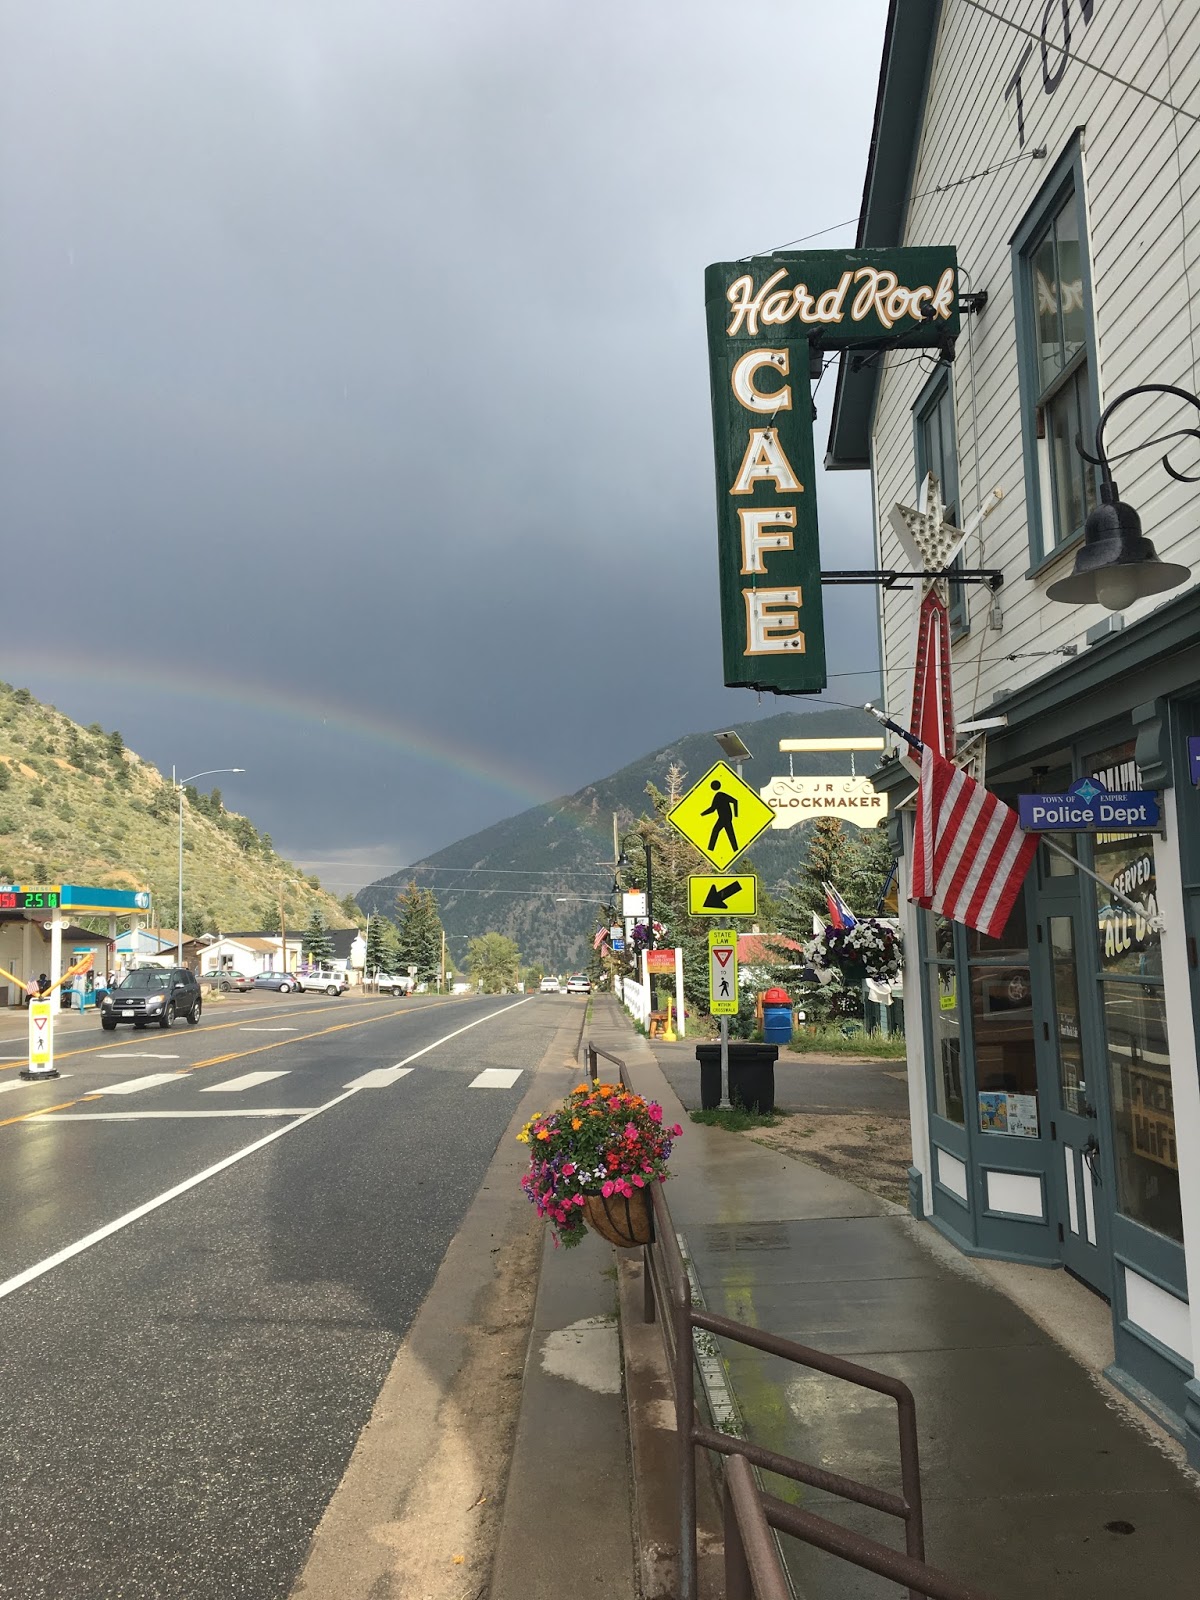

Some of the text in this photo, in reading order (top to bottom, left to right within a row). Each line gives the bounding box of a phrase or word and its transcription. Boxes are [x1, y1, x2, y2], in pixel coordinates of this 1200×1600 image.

[726, 267, 955, 336] Hard Rock
[730, 348, 806, 656] CAFE
[768, 797, 881, 808] CLOCKMAKER
[1033, 805, 1147, 825] Police Dept
[1041, 794, 1128, 804] TOWN OF EMPIRE
[1113, 857, 1151, 901] SERVED
[1105, 911, 1131, 958] ALL
